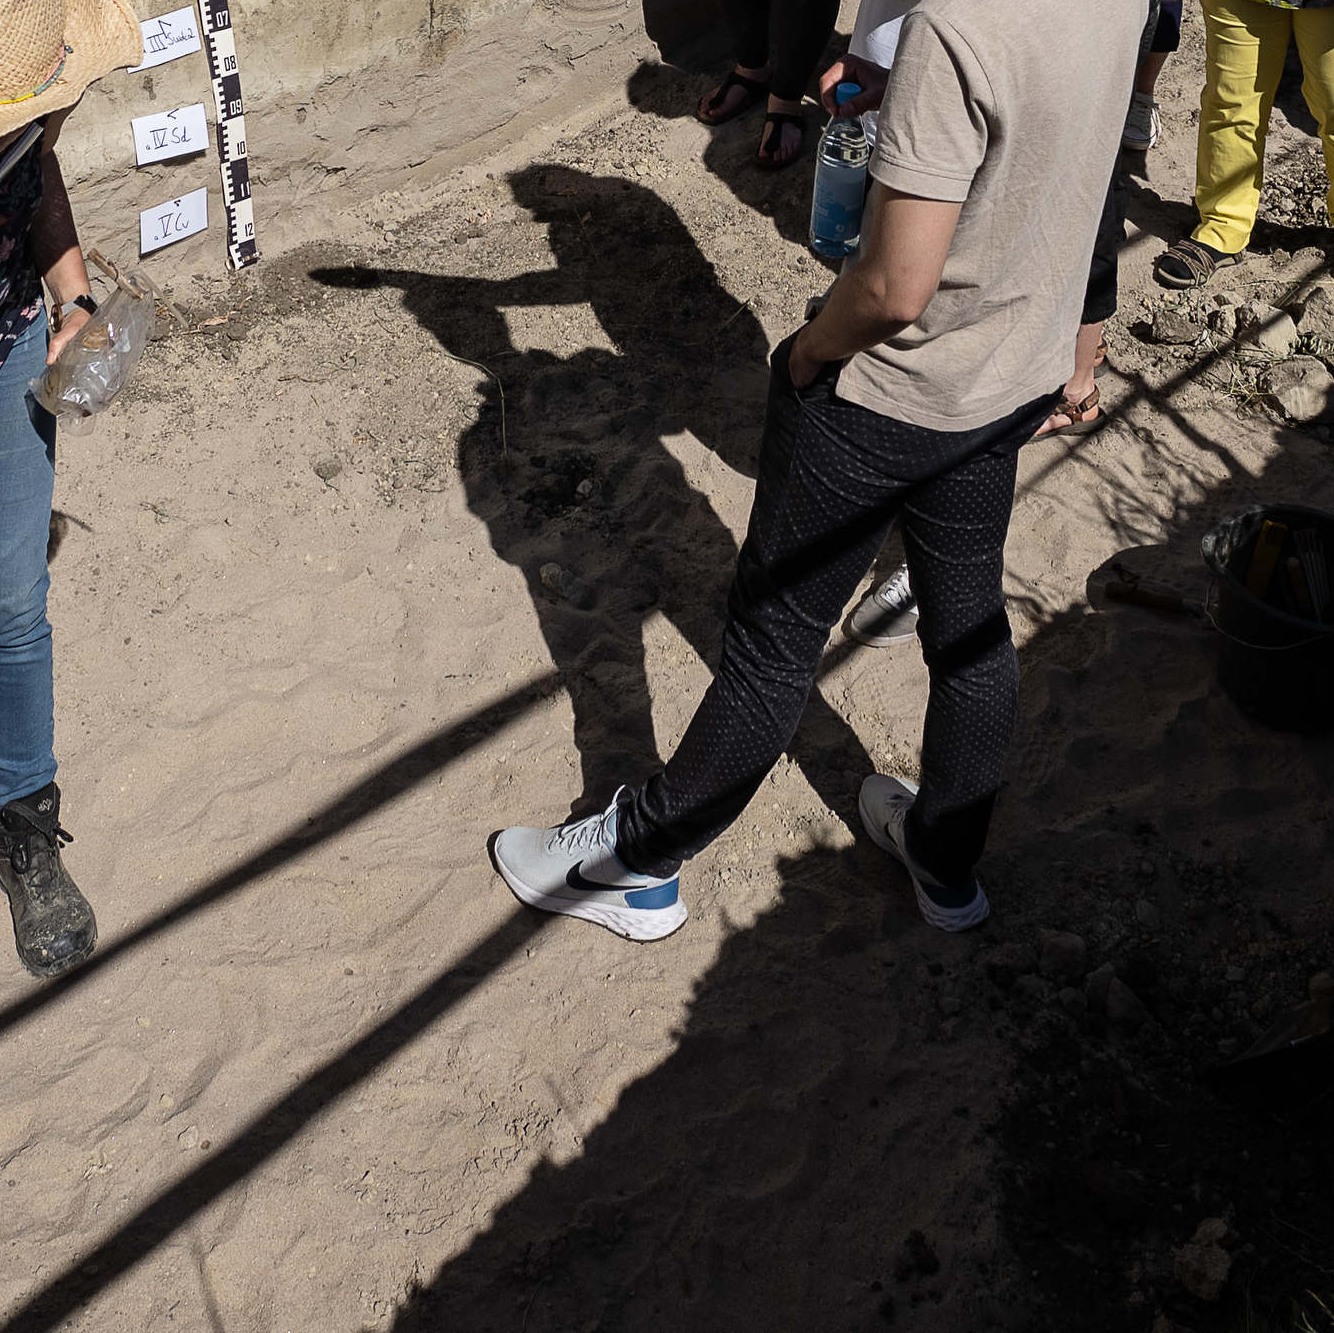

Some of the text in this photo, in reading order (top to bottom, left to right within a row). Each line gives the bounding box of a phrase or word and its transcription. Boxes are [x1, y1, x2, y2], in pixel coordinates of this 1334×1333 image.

[216, 11, 229, 28] 07
[224, 55, 236, 72] 08
[230, 99, 243, 115] 09
[237, 140, 246, 155] 10
[240, 182, 250, 197] 11
[244, 222, 253, 237] 12
